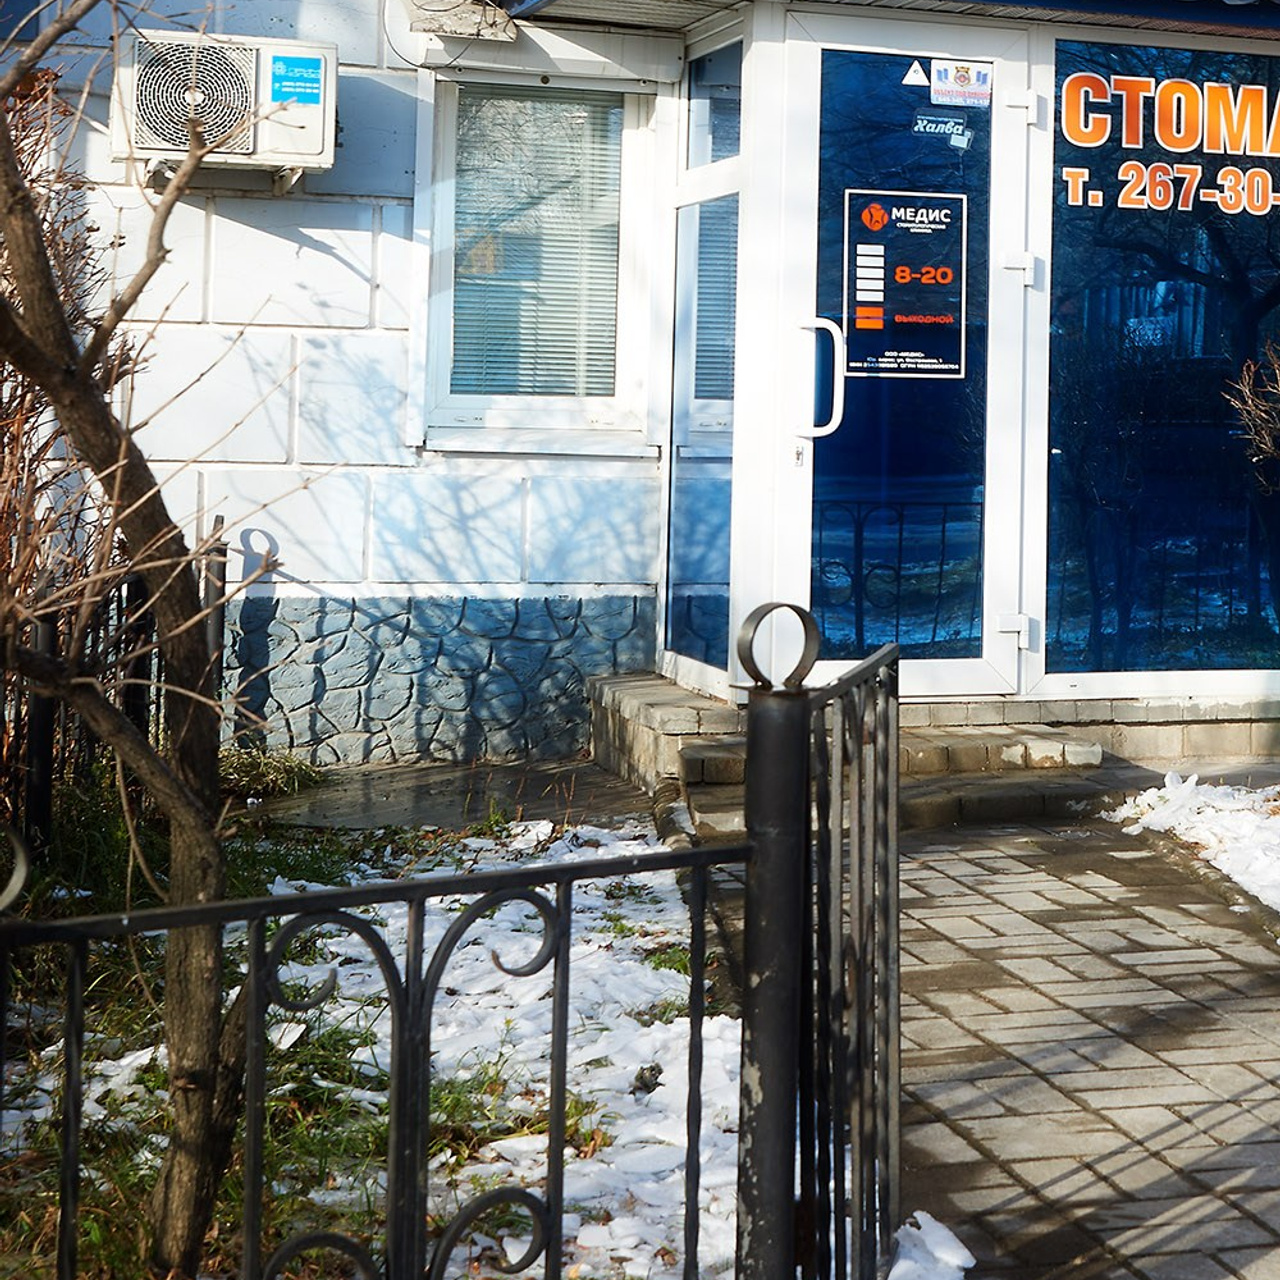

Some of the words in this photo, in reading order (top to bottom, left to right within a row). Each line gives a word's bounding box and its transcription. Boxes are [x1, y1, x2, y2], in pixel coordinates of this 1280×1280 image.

[914, 120, 964, 134] Халва
[891, 207, 951, 224] МЕДИС
[894, 266, 954, 284] 8-20
